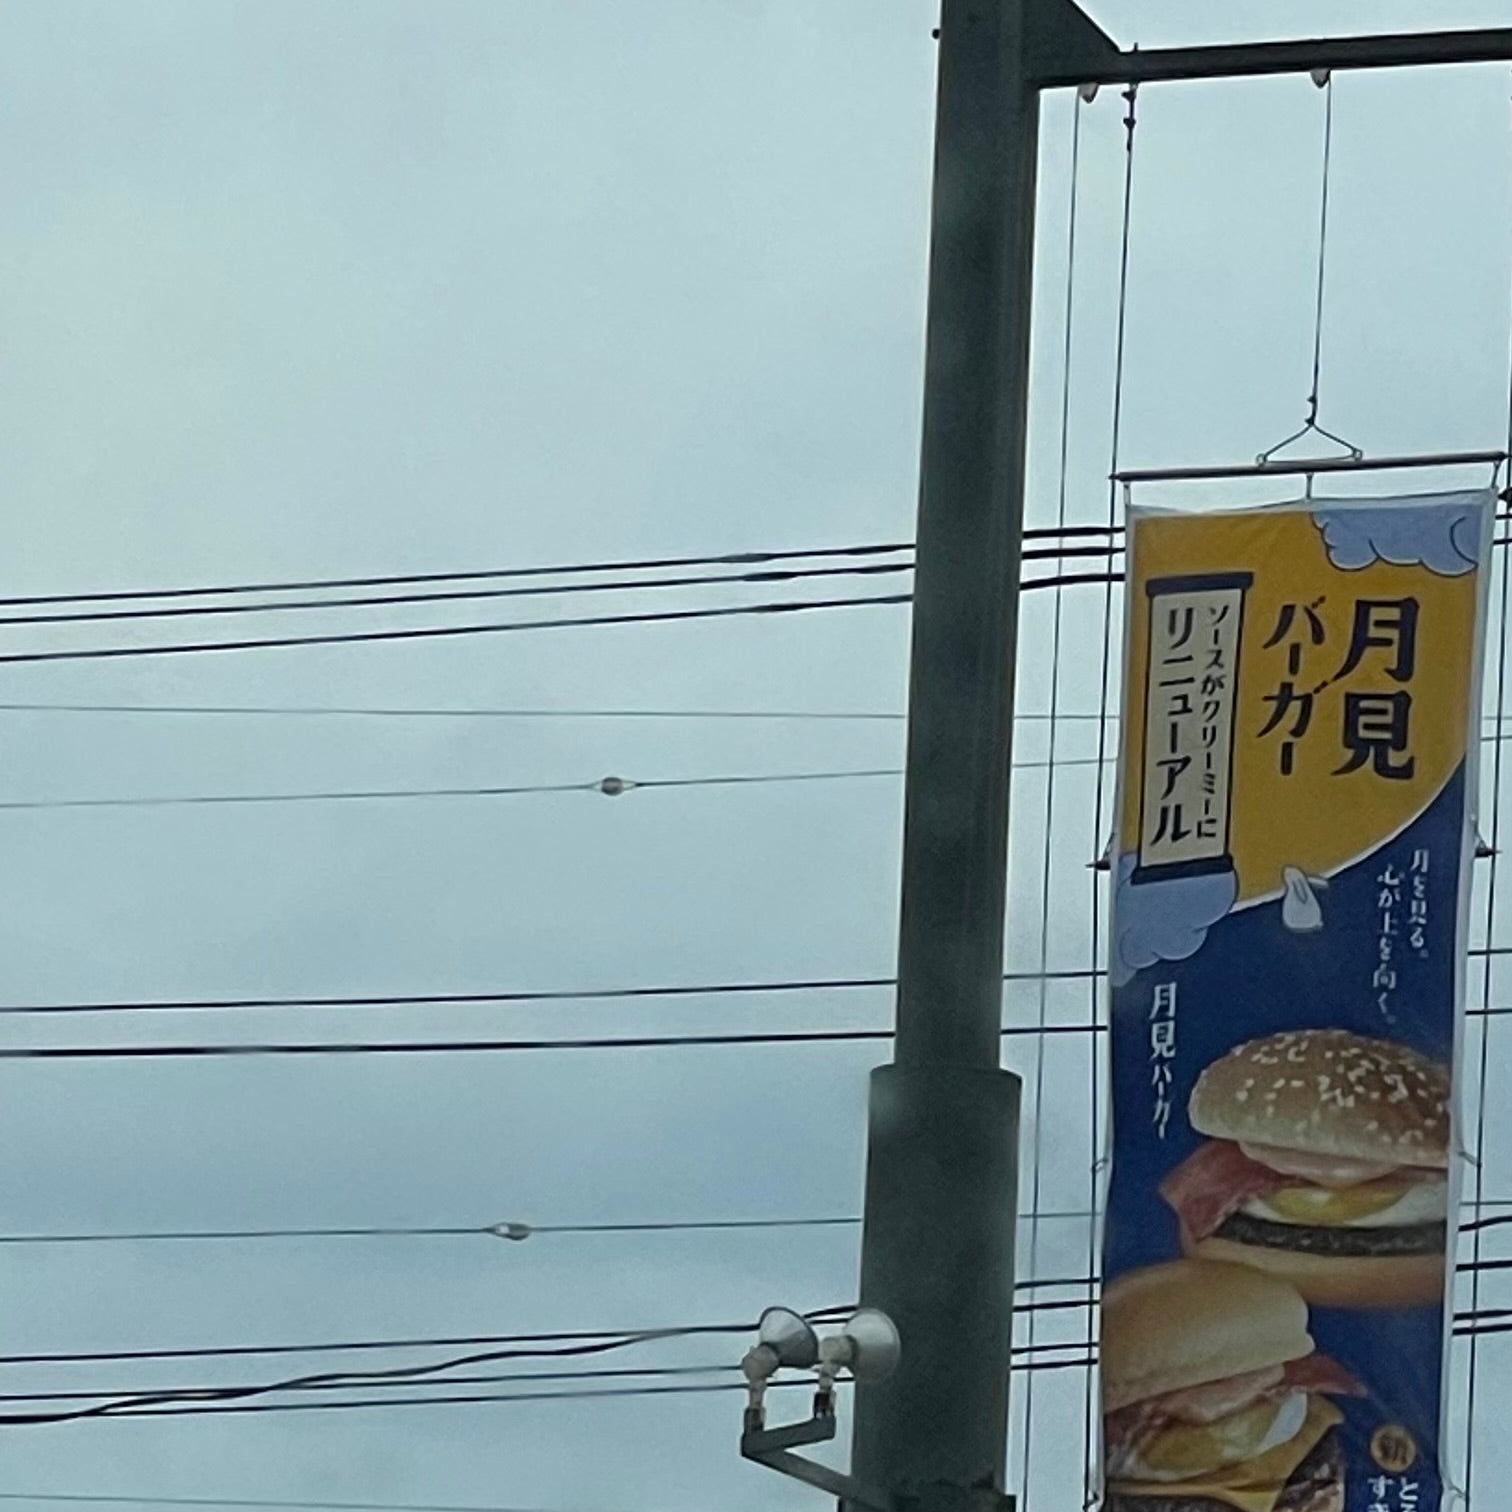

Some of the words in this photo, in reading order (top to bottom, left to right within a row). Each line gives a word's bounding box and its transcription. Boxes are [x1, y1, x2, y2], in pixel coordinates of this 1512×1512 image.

[1150, 606, 1195, 846] リニューアル
[1197, 604, 1230, 839] ソースがクリーミーに
[1257, 595, 1328, 776] バーガー
[1331, 595, 1420, 780] 月見
[1149, 981, 1177, 1140] 月見バーガー
